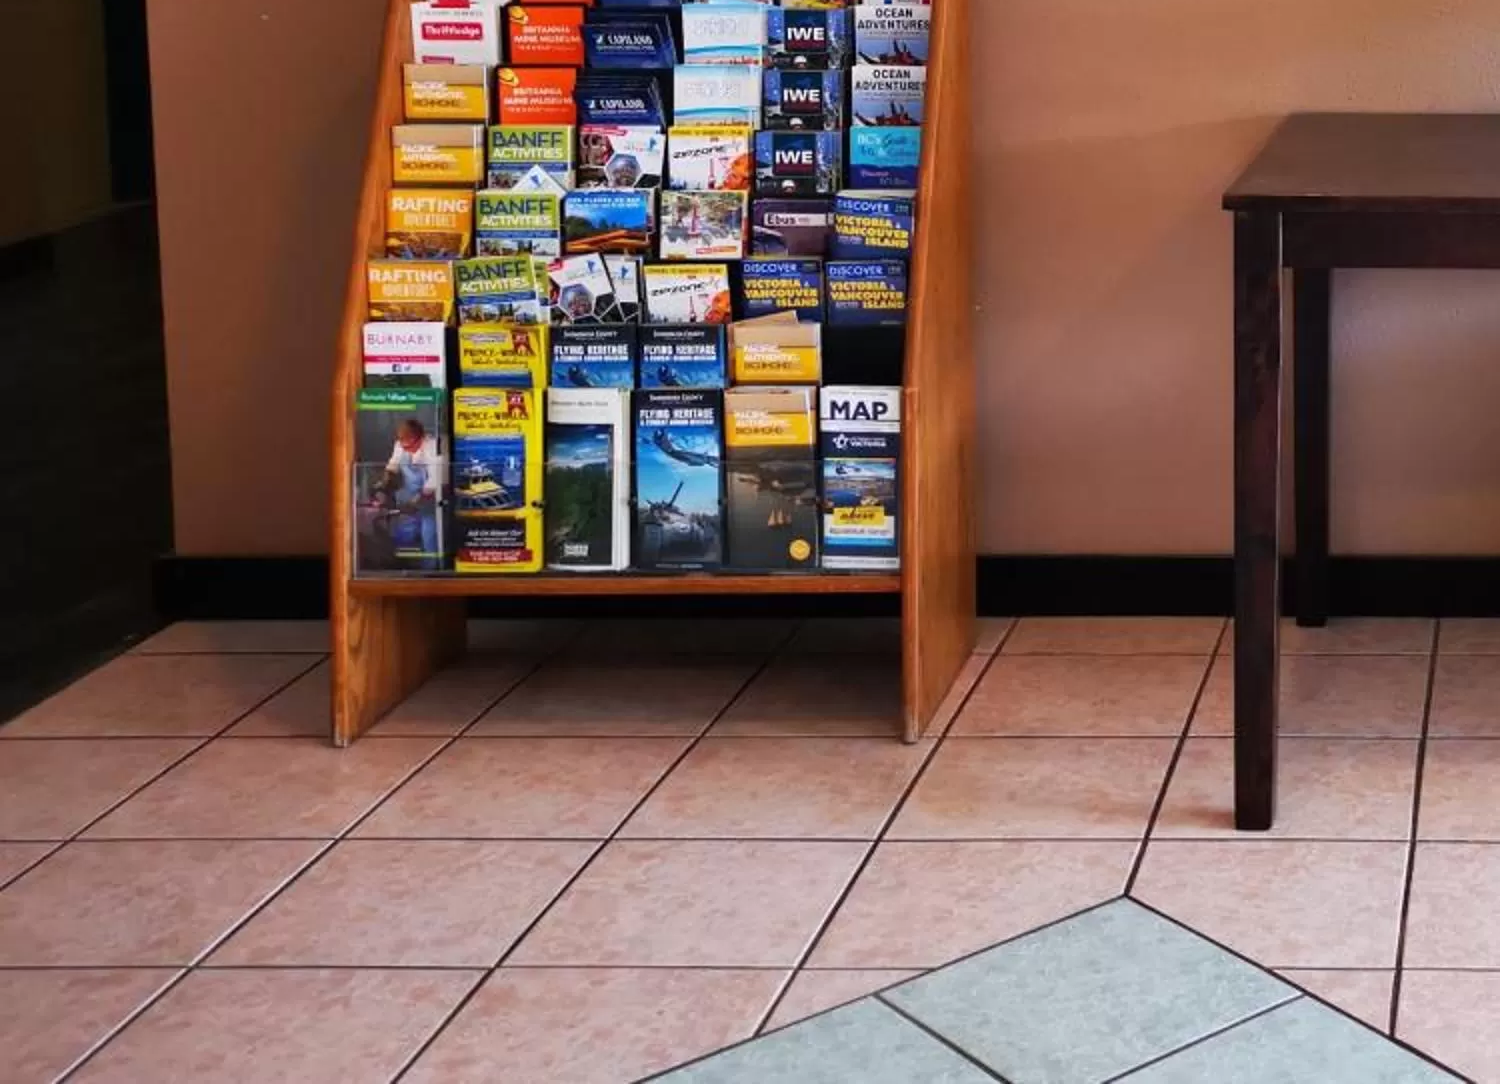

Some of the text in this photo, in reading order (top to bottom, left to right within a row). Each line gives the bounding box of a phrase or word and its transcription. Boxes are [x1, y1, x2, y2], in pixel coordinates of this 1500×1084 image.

[875, 8, 913, 18] OCEAN
[857, 19, 930, 30] ADVENTURES
[786, 27, 825, 41] IWE
[872, 69, 911, 79] OCEAN
[783, 88, 820, 103] IWE
[492, 131, 564, 148] BANFF
[491, 147, 563, 160] ACTIVITIES
[775, 150, 814, 165] IWE
[391, 197, 469, 214] RAFTING
[479, 198, 553, 215] BANFF
[837, 200, 890, 213] DISCOVER
[480, 215, 553, 227] ACTIVITIES
[835, 215, 893, 229] VICTORIA
[835, 225, 909, 239] VANCOUVER
[864, 236, 909, 249] ISLAND
[457, 260, 527, 281] BANFF
[743, 262, 798, 273] DISCOVER
[829, 266, 884, 276] DISCOVER
[368, 269, 447, 284] RAFTING
[460, 278, 531, 293] ACTIVITIES
[743, 279, 802, 289] VICTORIA
[829, 281, 888, 291] VICTORIA
[743, 289, 818, 299] VANCOUVER
[829, 291, 904, 301] VANCOUVER
[775, 298, 819, 308] ISLAND
[862, 301, 905, 310] ISLAND
[367, 332, 433, 345] BURNABY
[829, 400, 889, 421] MAP
